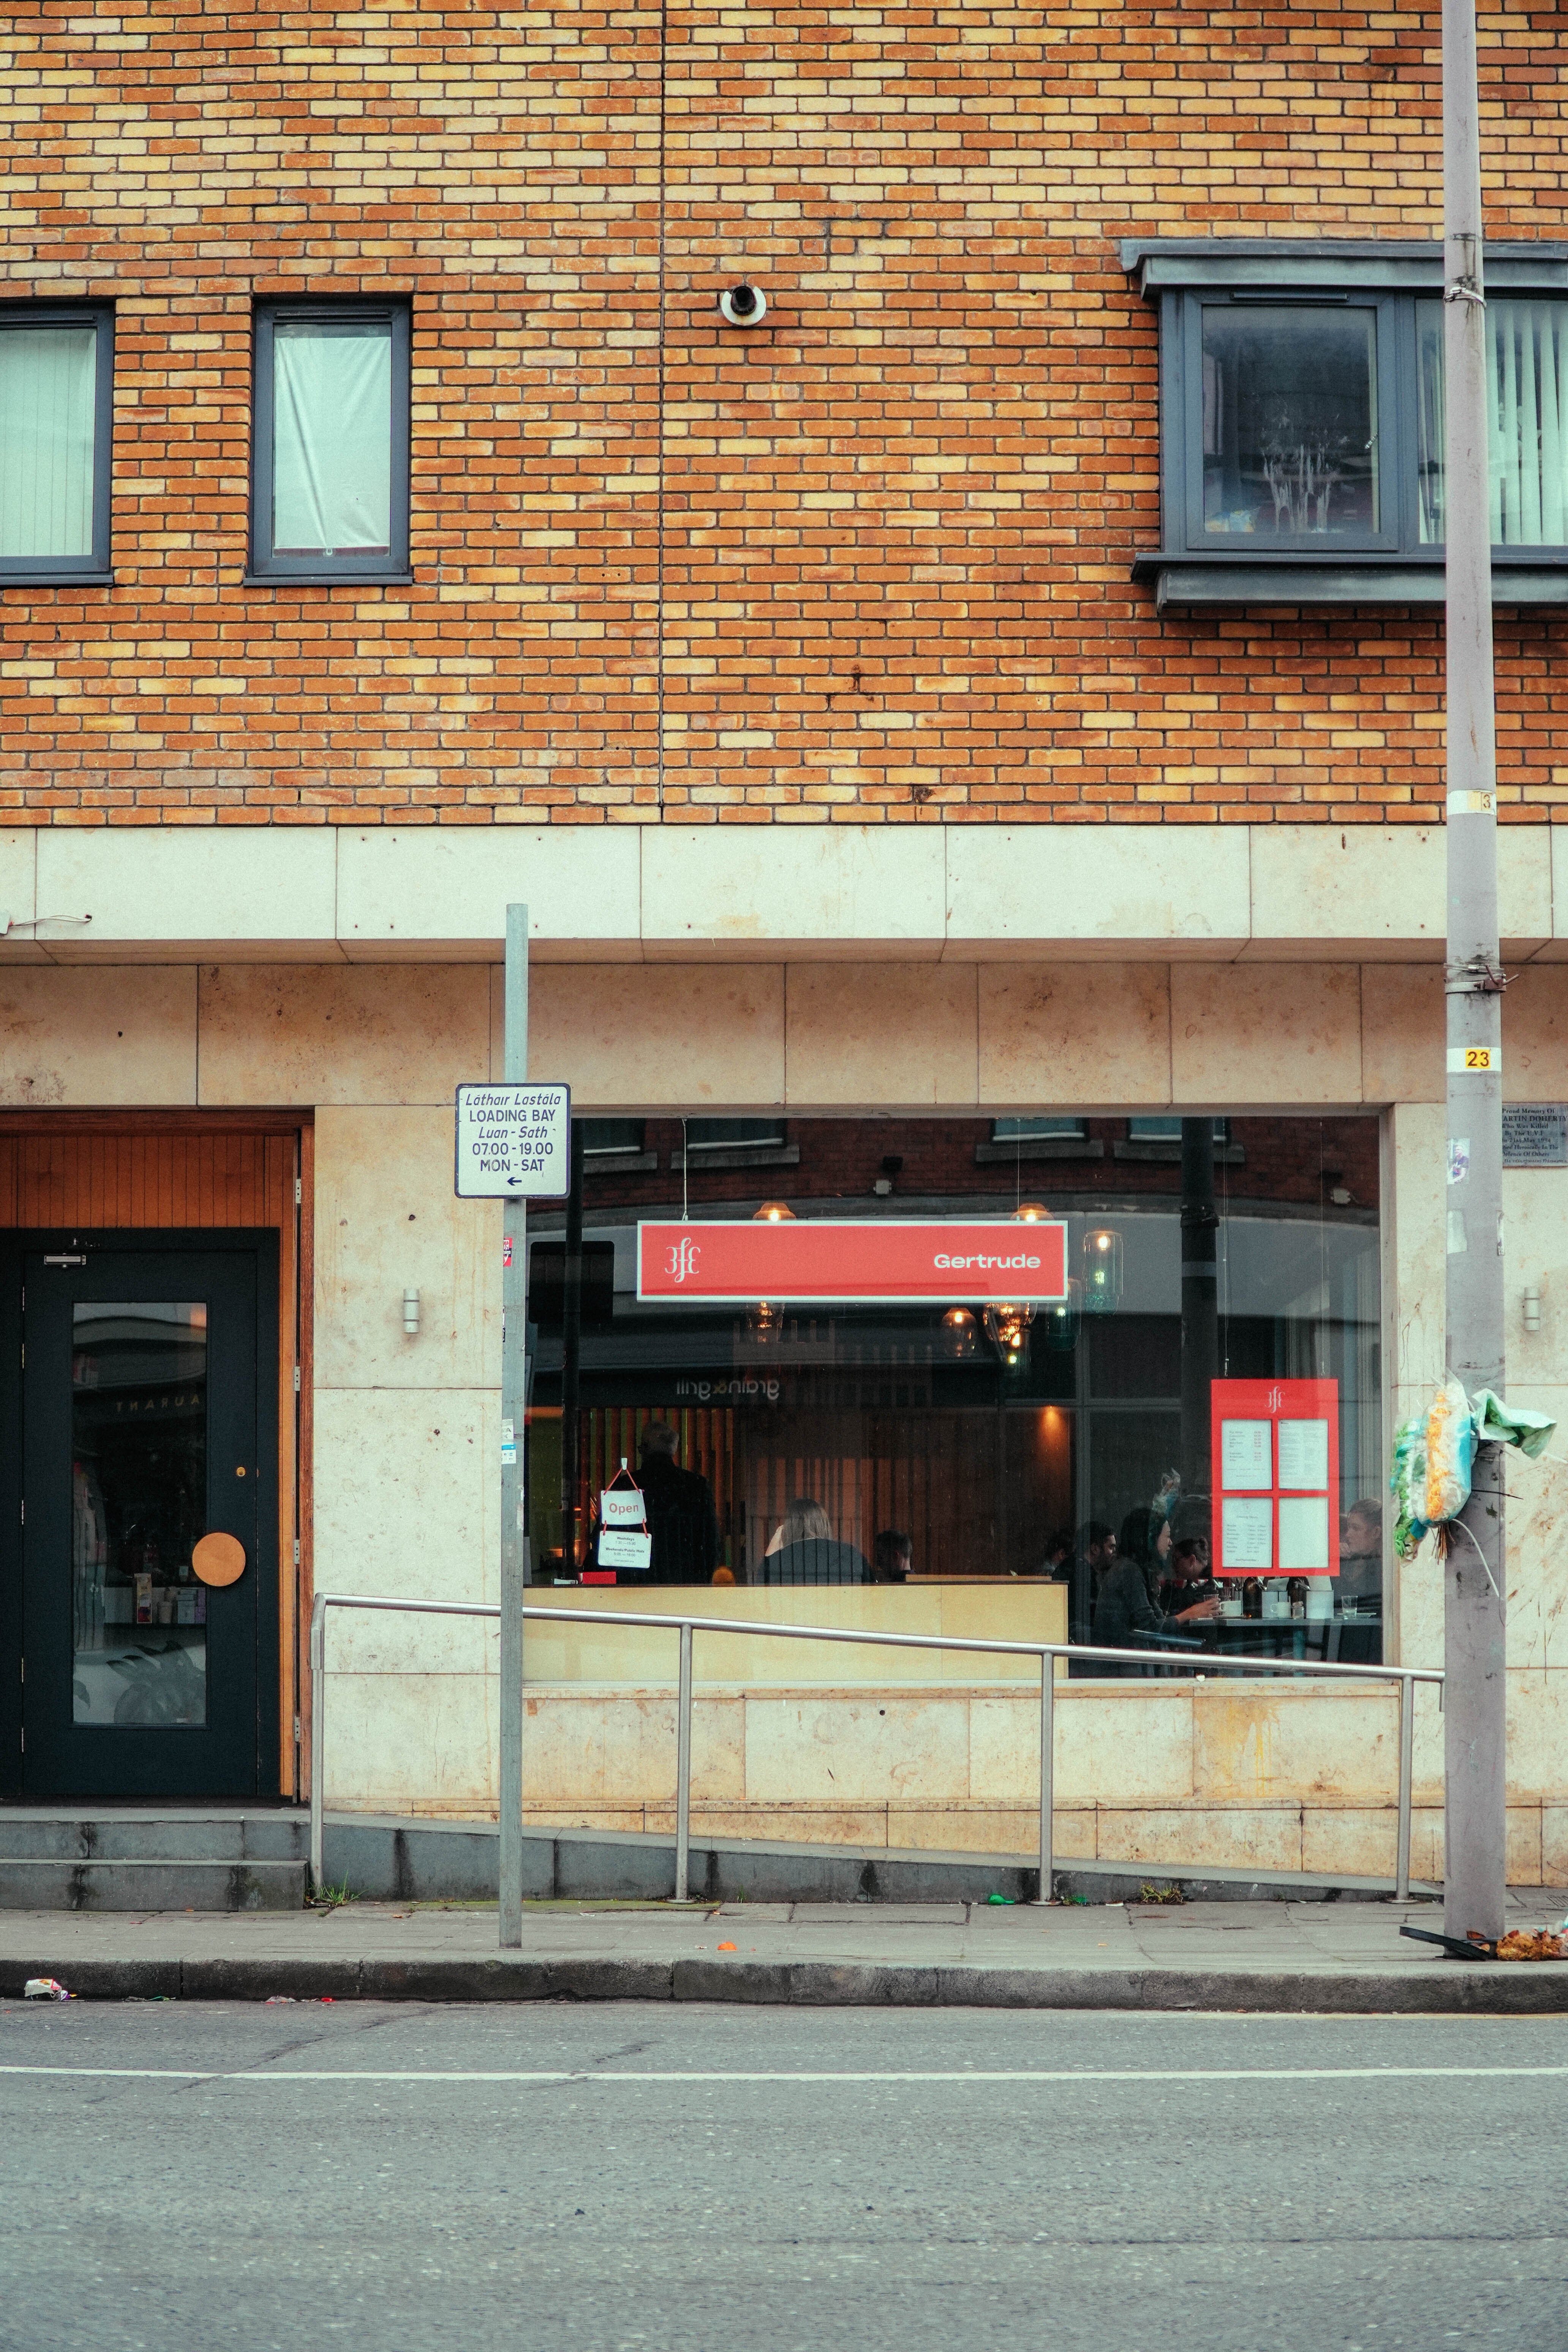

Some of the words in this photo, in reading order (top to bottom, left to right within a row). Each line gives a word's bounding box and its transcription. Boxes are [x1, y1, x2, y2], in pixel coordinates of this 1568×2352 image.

[1483, 794, 1491, 808] 3
[1468, 1051, 1489, 1067] 23
[514, 1093, 561, 1105] Lastála
[469, 1110, 526, 1122] LOADING
[532, 1110, 556, 1121] BAY
[479, 1127, 508, 1138] Luan
[518, 1126, 548, 1138] Sath
[472, 1143, 509, 1155] 07.00
[519, 1142, 553, 1155] 19.00
[481, 1159, 510, 1171] MON
[521, 1159, 545, 1171] SAT
[934, 1254, 1041, 1269] Gertrude
[609, 1503, 639, 1515] Open
